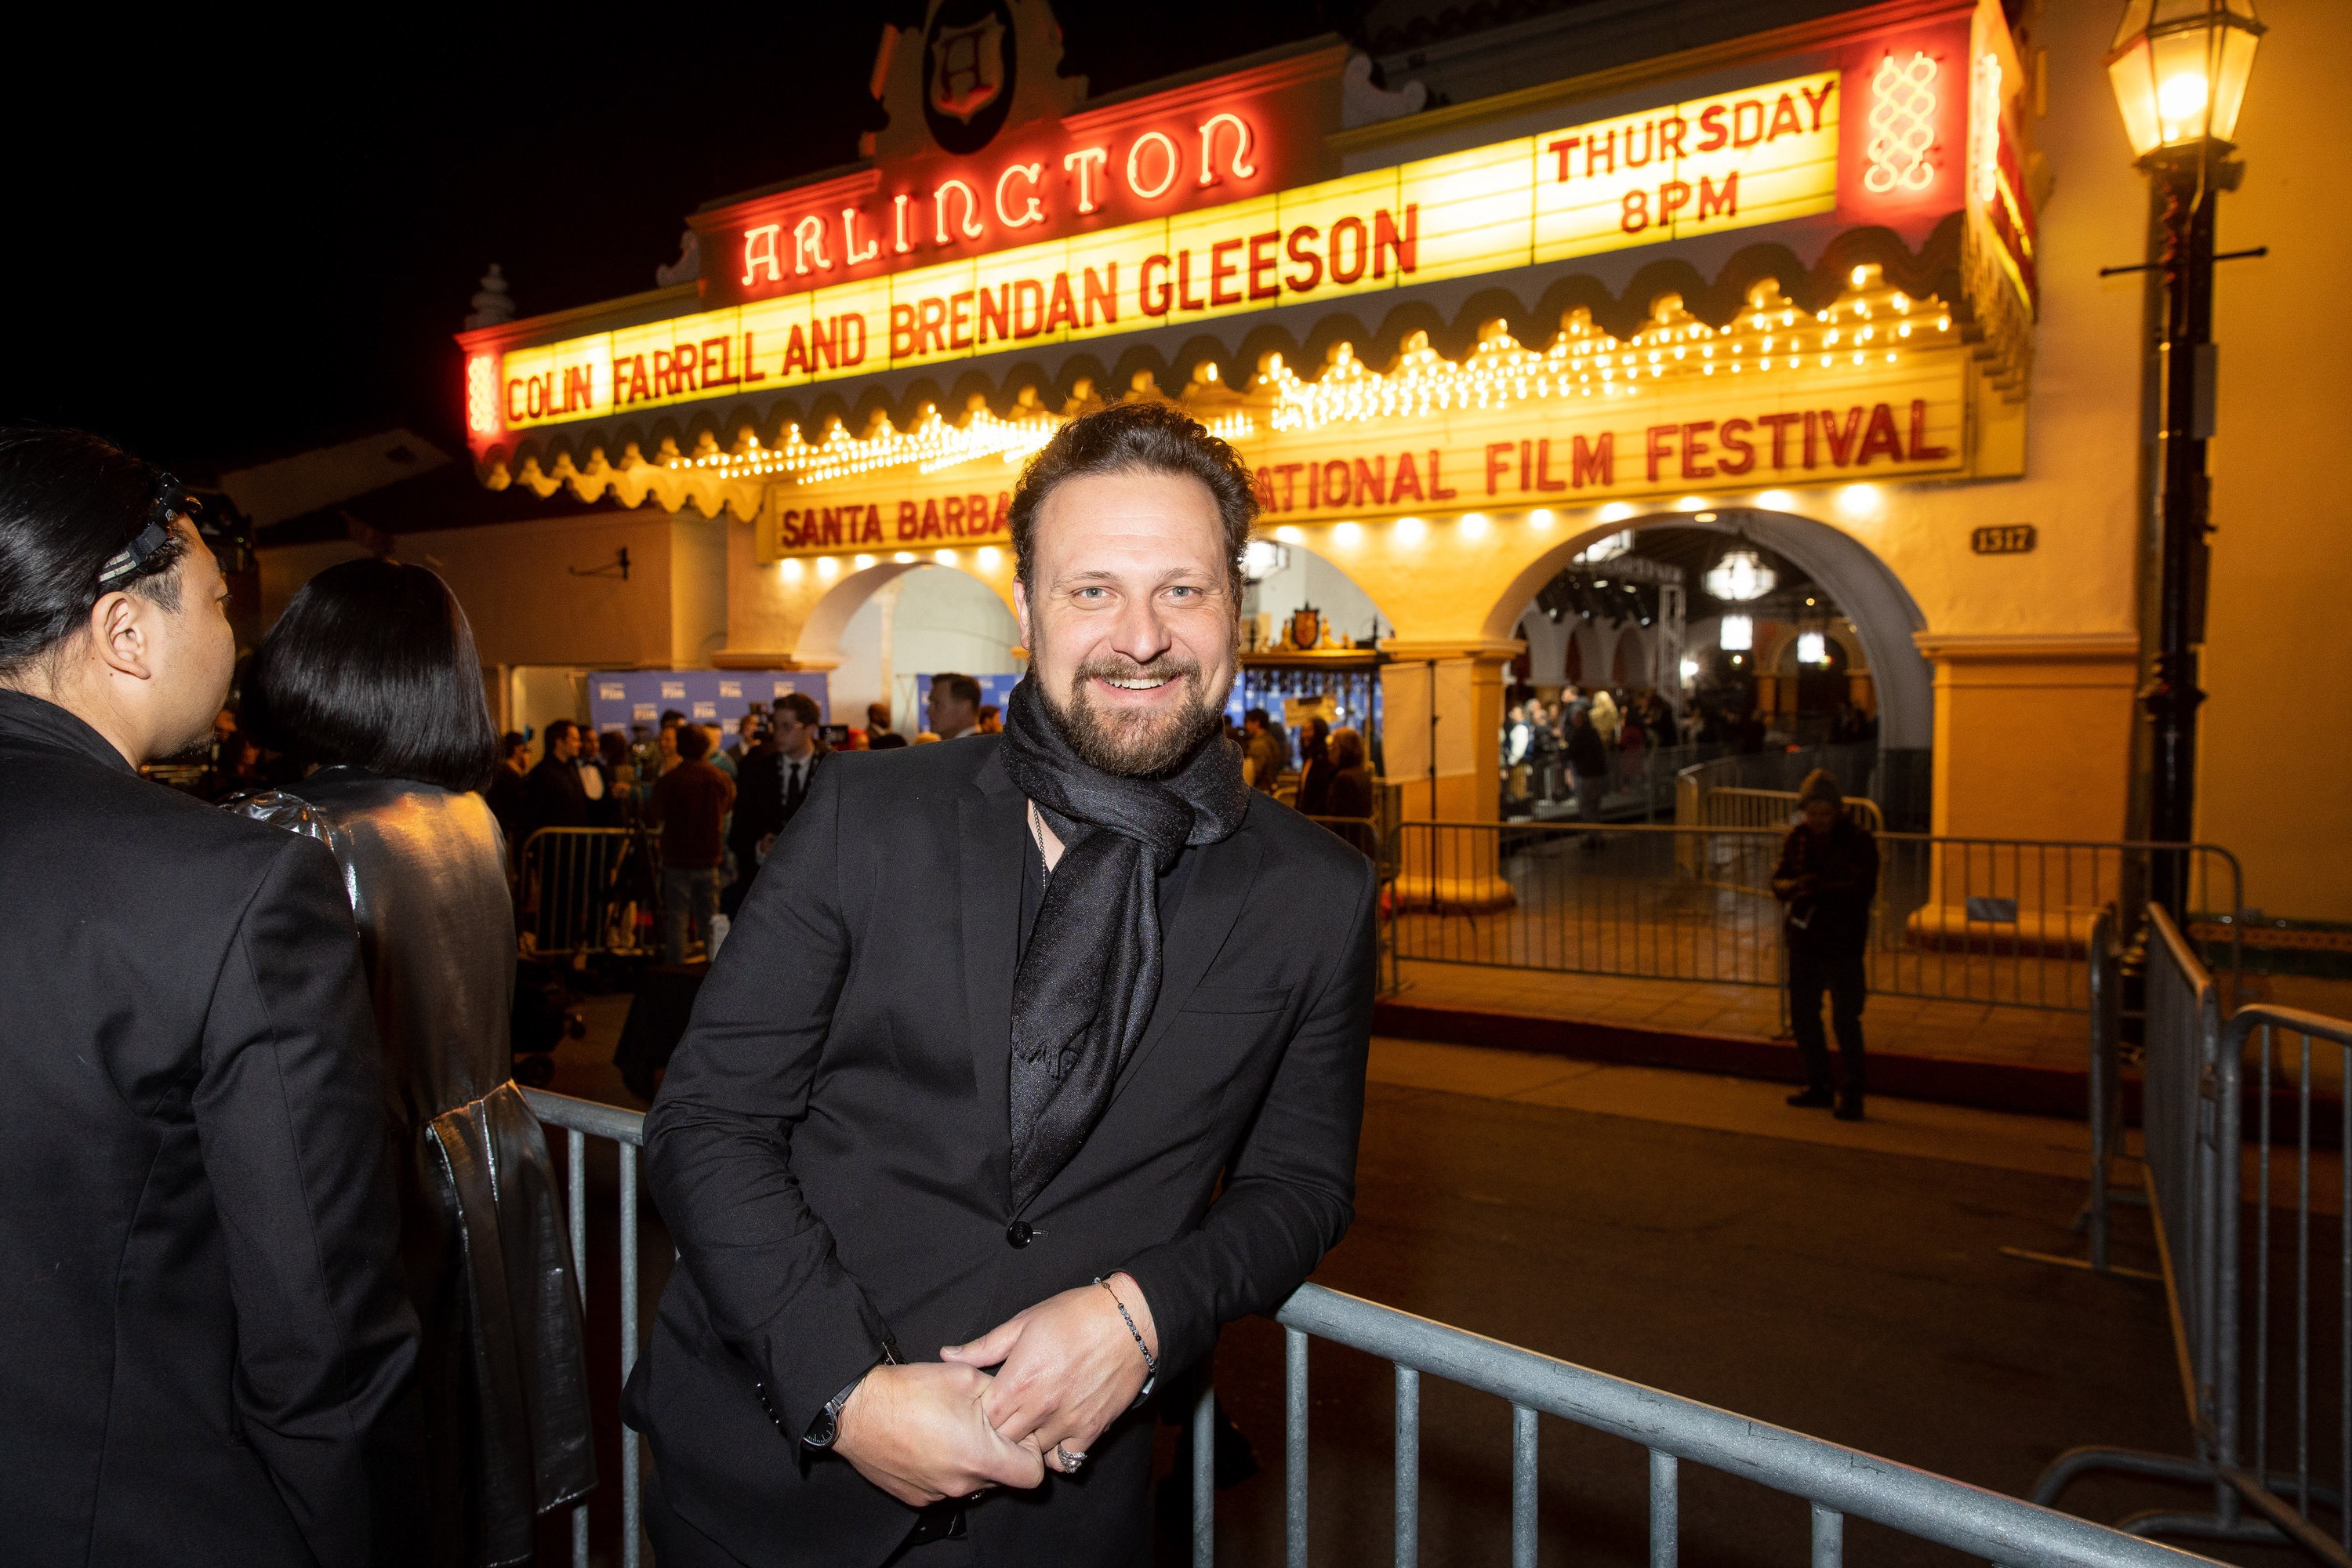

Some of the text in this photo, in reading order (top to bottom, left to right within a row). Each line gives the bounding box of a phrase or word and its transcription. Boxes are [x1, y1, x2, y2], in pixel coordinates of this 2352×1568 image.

[742, 113, 1254, 285] ARLINGTON
[1548, 79, 1835, 183] THURSDAY
[1621, 170, 1739, 234] 8PM
[506, 203, 1419, 422] COLIN FARRELL AND BRENDAN GLEESON
[781, 398, 1950, 548] SANTA BARBA ATIONAL FILM FESTIVAL
